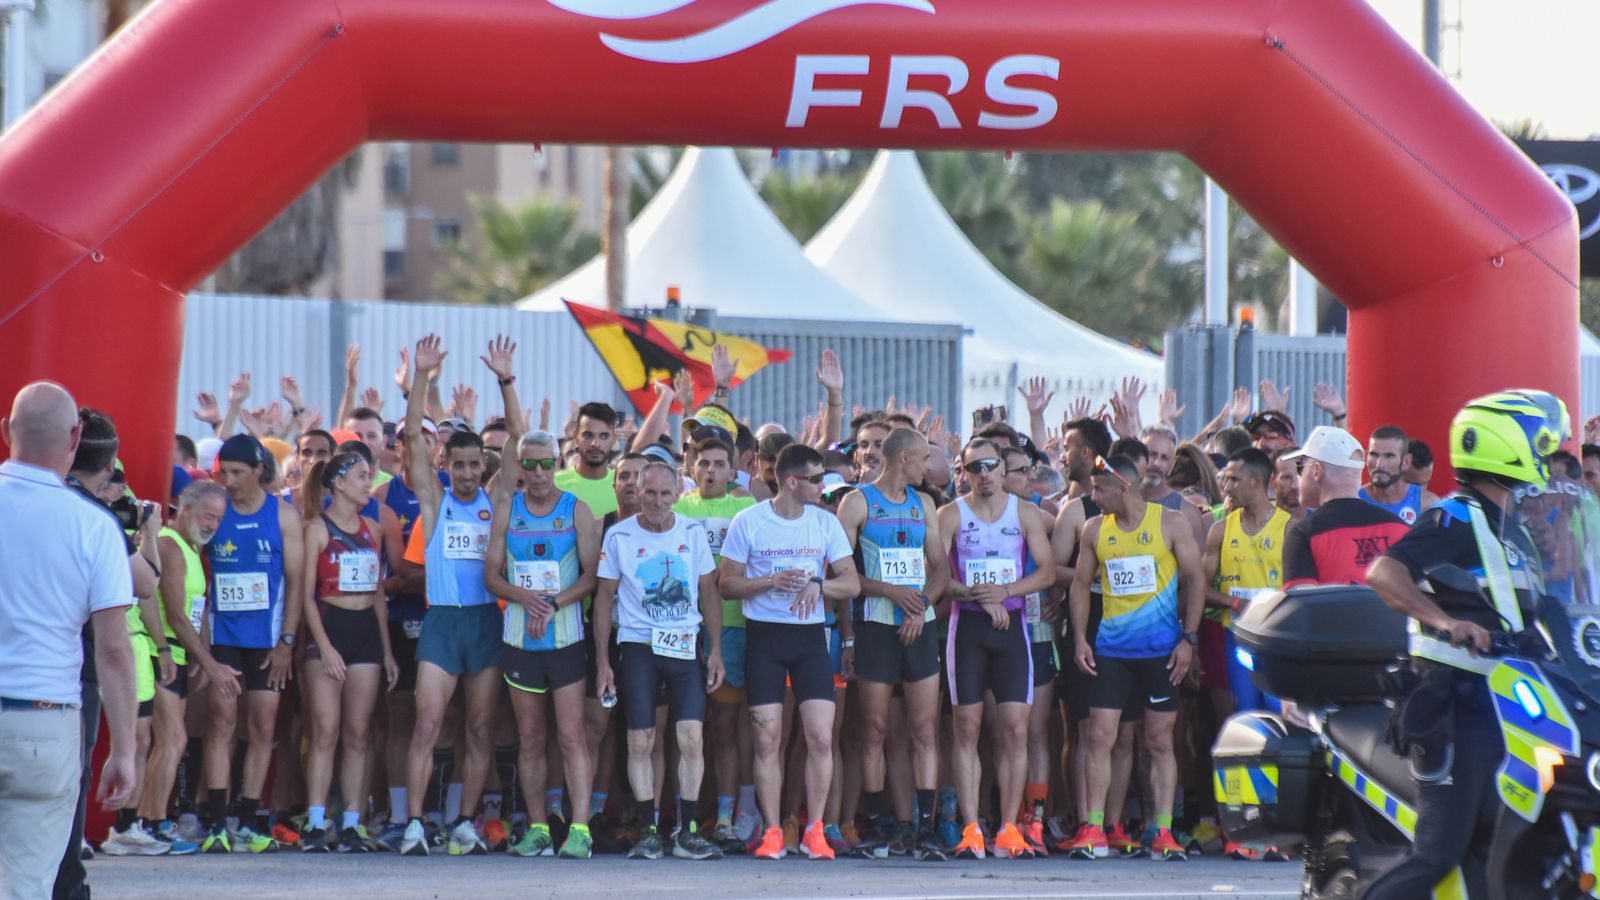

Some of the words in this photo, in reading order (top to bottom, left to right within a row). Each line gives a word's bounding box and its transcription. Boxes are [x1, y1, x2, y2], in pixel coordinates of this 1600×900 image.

[785, 54, 1060, 130] FRS
[448, 534, 470, 549] 219
[706, 530, 715, 544] 3
[351, 567, 359, 581] 2
[884, 561, 907, 575] 713
[520, 575, 533, 589] 75
[973, 571, 996, 585] 815
[1113, 570, 1135, 586] 922
[221, 587, 245, 601] 513
[657, 631, 679, 648] 742
